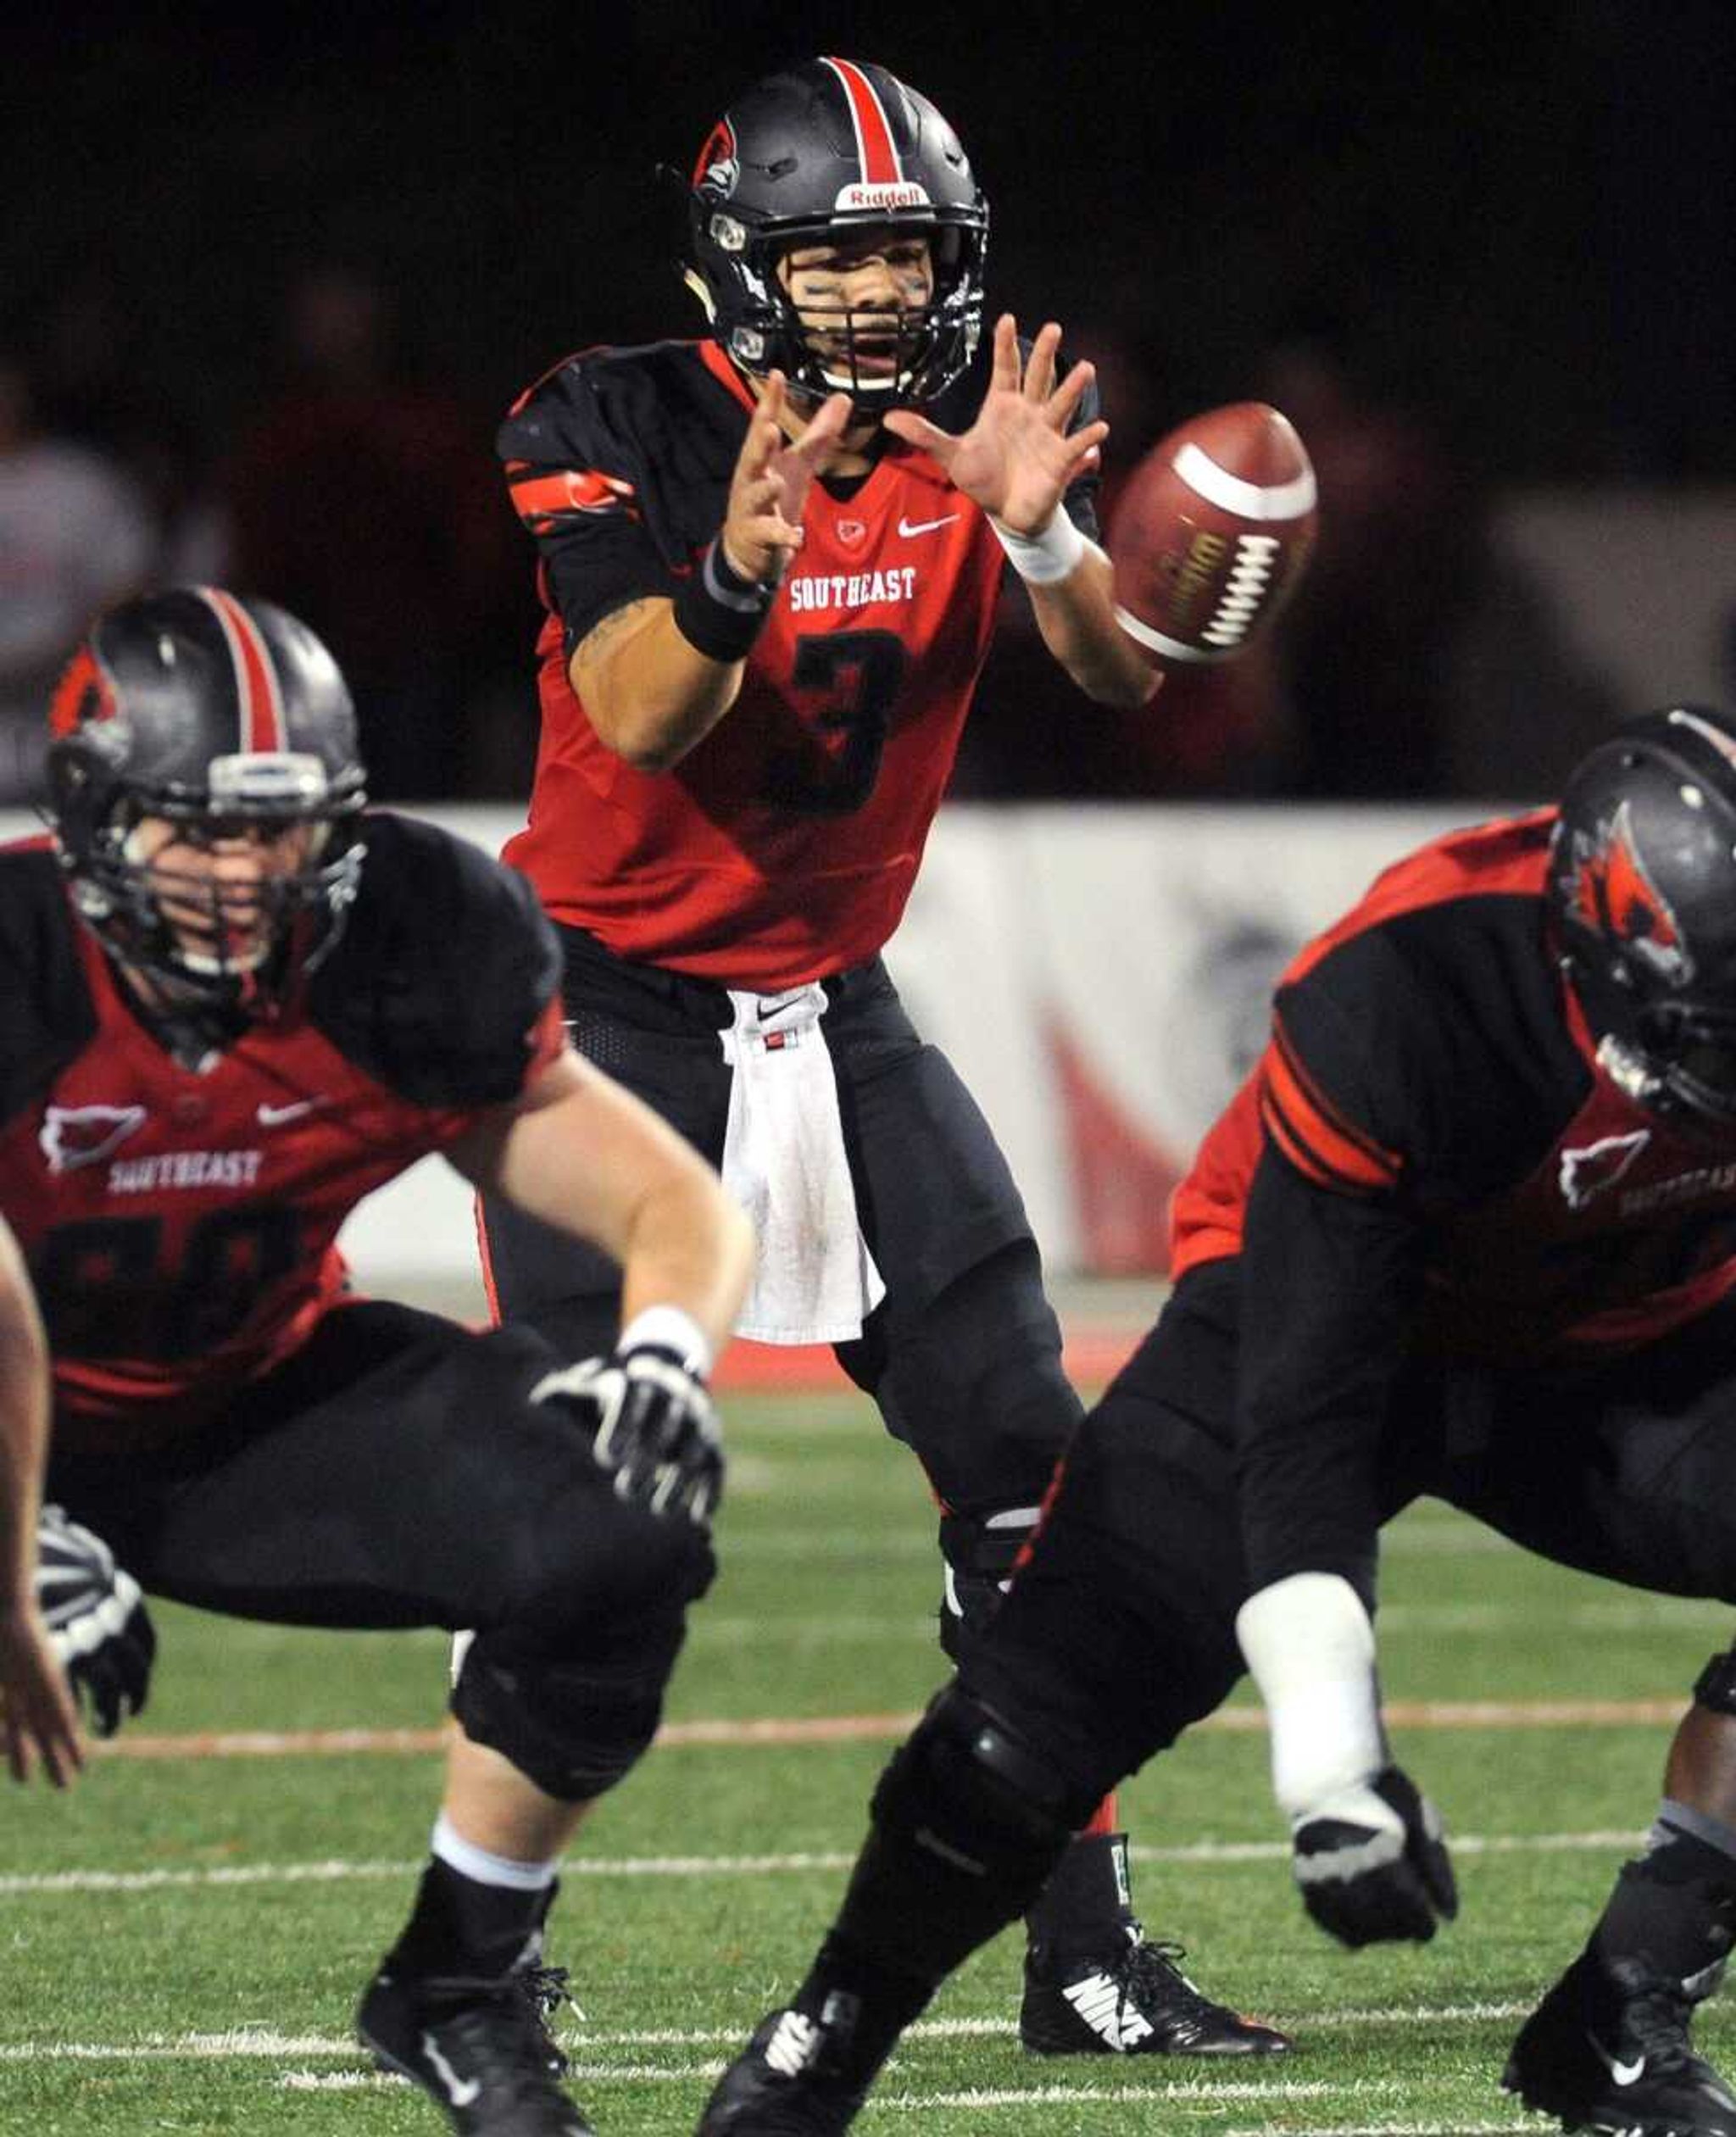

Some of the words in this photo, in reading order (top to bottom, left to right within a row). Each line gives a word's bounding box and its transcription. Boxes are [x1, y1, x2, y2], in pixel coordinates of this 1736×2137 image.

[851, 188, 920, 205] Riddell
[790, 567, 916, 611] SOUTHEAST
[773, 628, 907, 814] 3
[1062, 1972, 1155, 2051] NIKE
